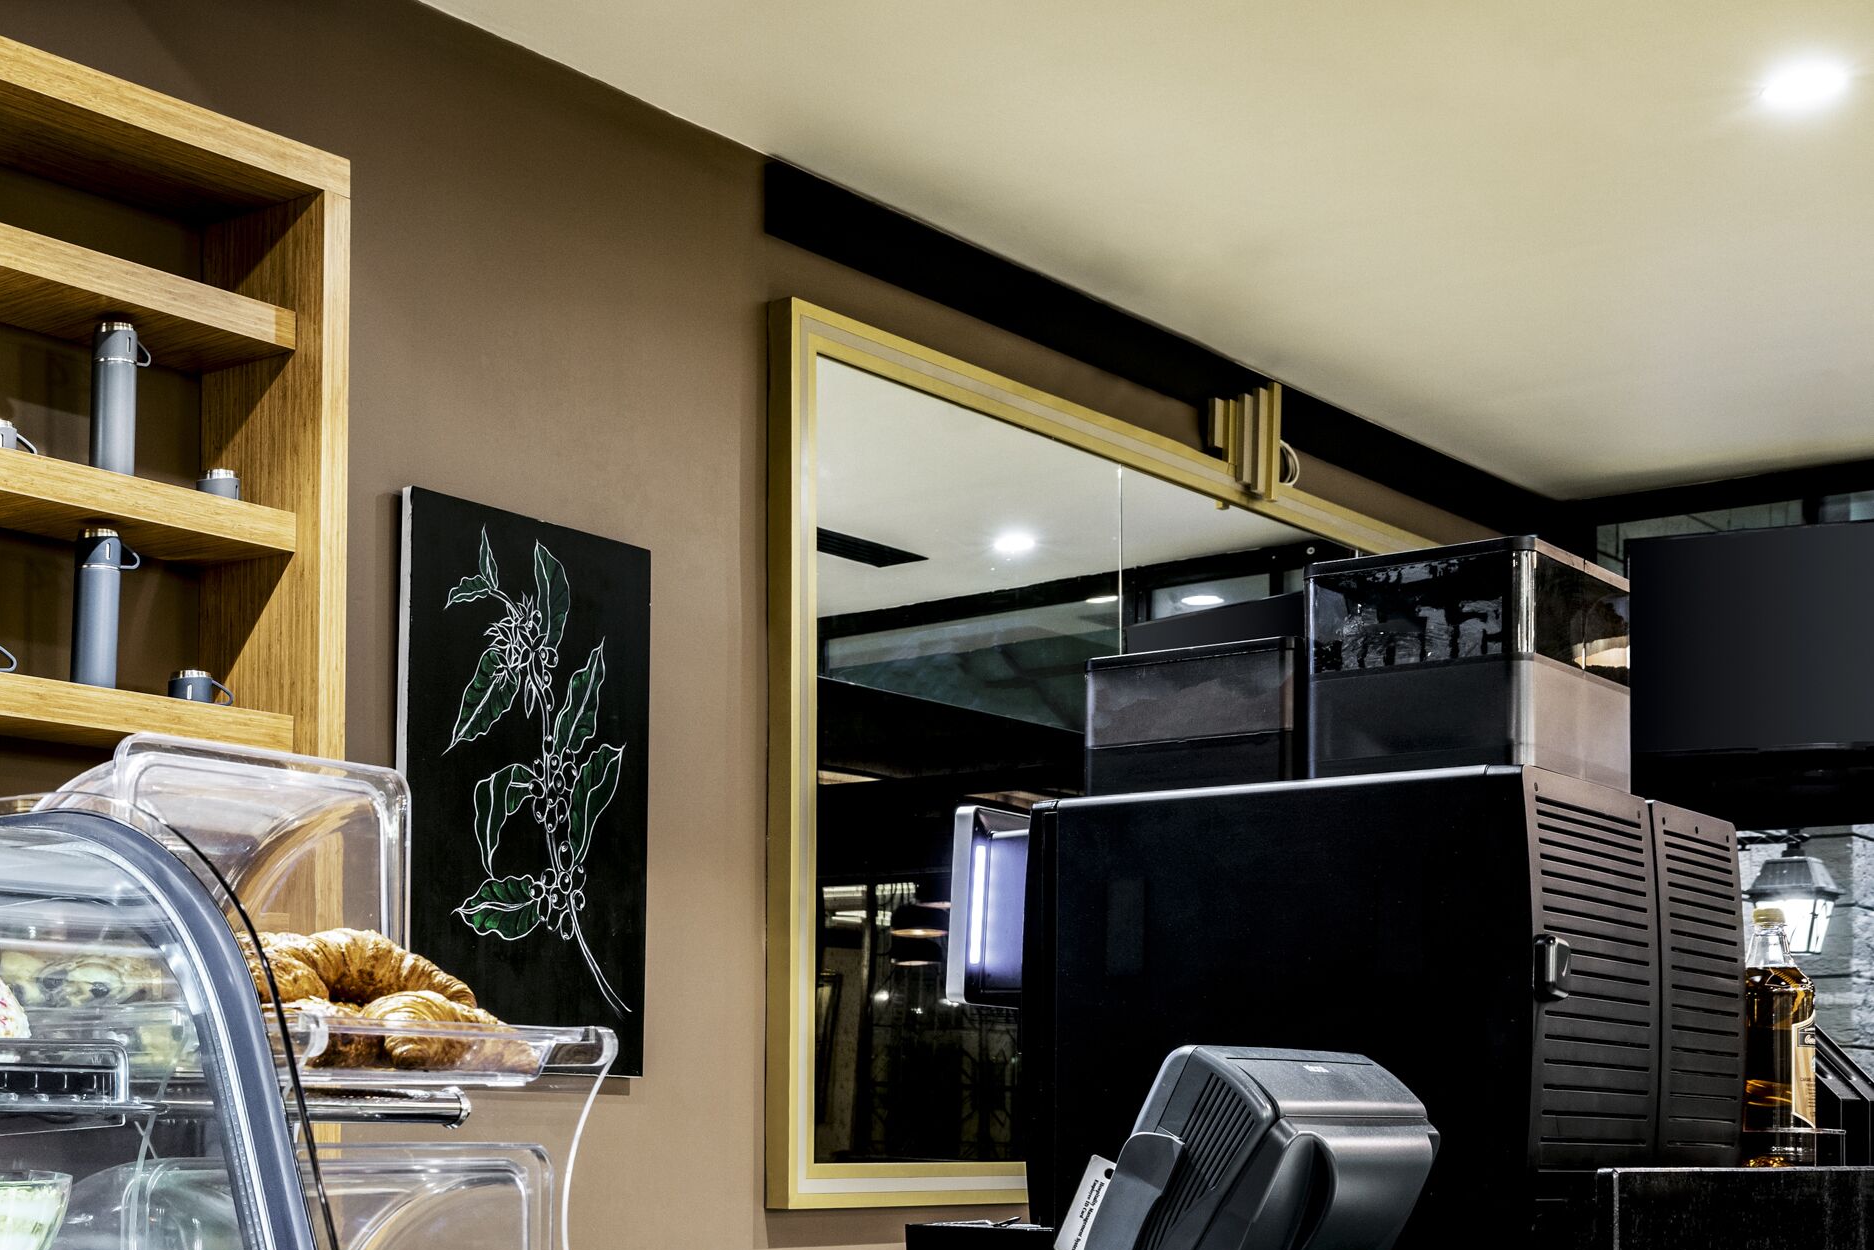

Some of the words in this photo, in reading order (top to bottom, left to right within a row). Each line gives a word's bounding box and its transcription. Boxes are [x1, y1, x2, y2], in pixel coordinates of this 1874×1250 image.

[1087, 1179, 1099, 1201] Employee
[1091, 1181, 1105, 1207] Hospitality
[1078, 1208, 1094, 1238] Management
